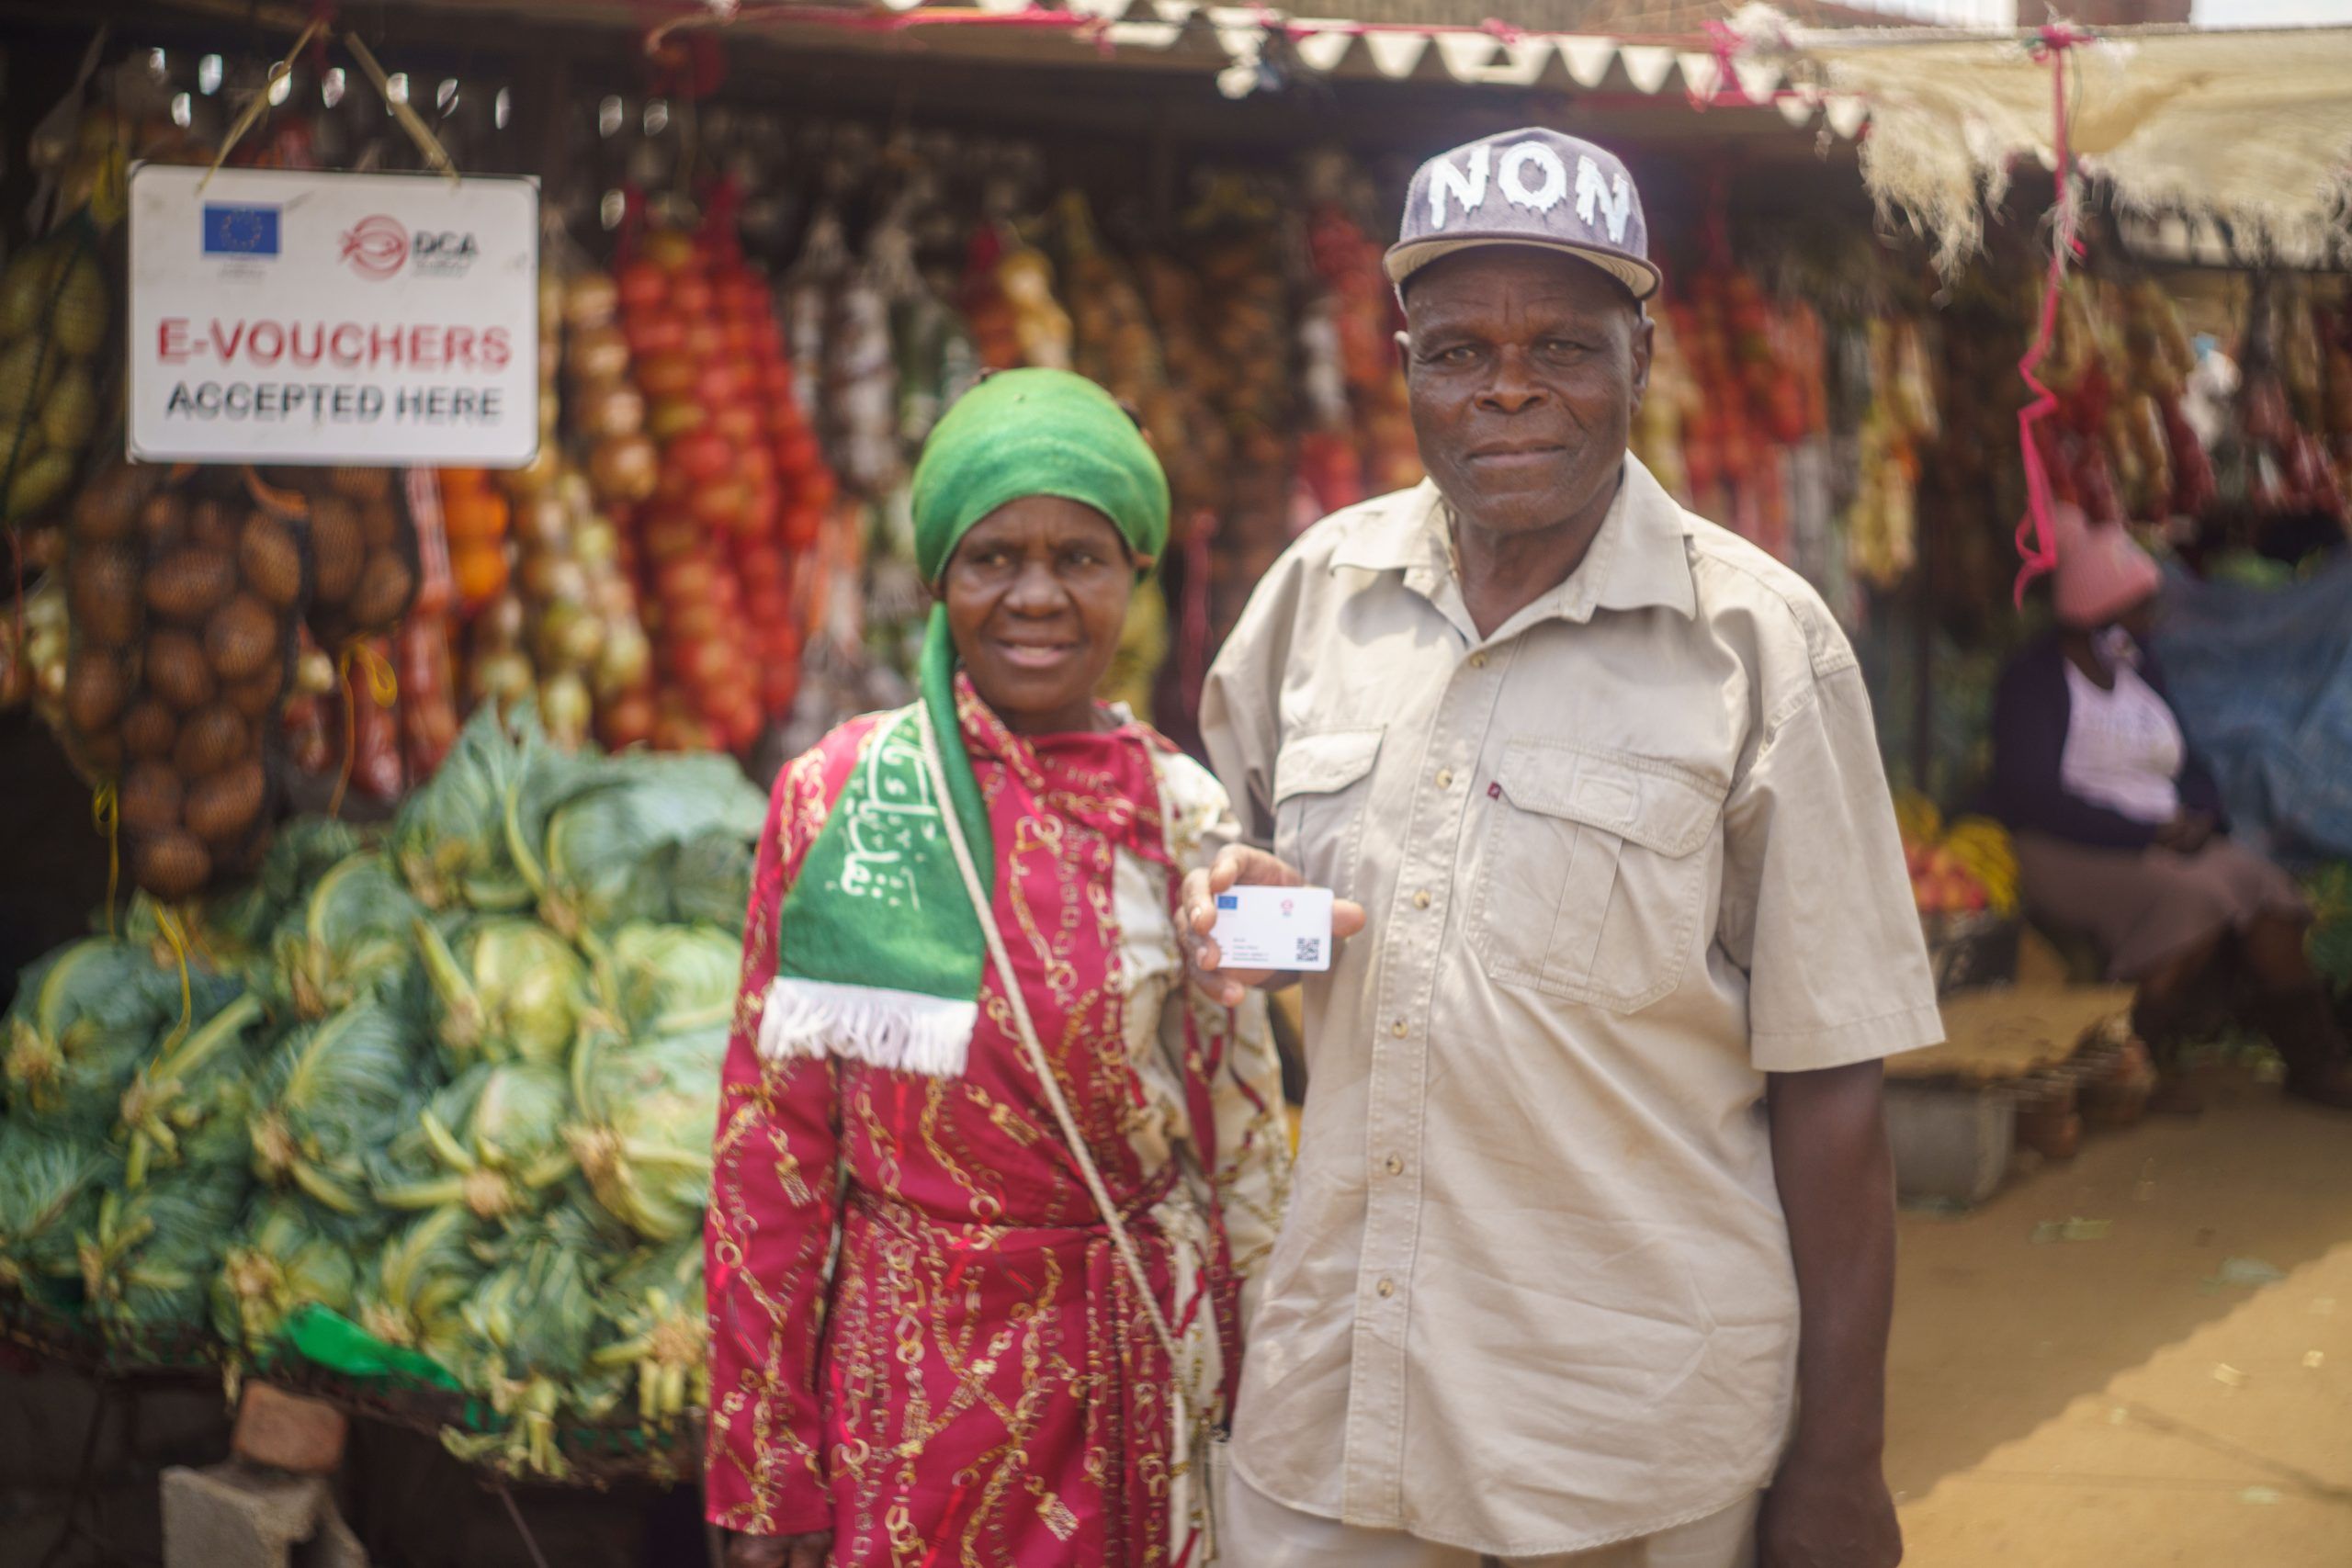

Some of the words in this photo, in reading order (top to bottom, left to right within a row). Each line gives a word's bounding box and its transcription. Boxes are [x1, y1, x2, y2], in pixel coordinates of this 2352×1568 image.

[1429, 140, 1630, 244] NON
[413, 230, 480, 258] DCA
[157, 319, 511, 371] E-VOUCHERS
[166, 381, 384, 423] ACCEPTED
[395, 386, 503, 425] HERE
